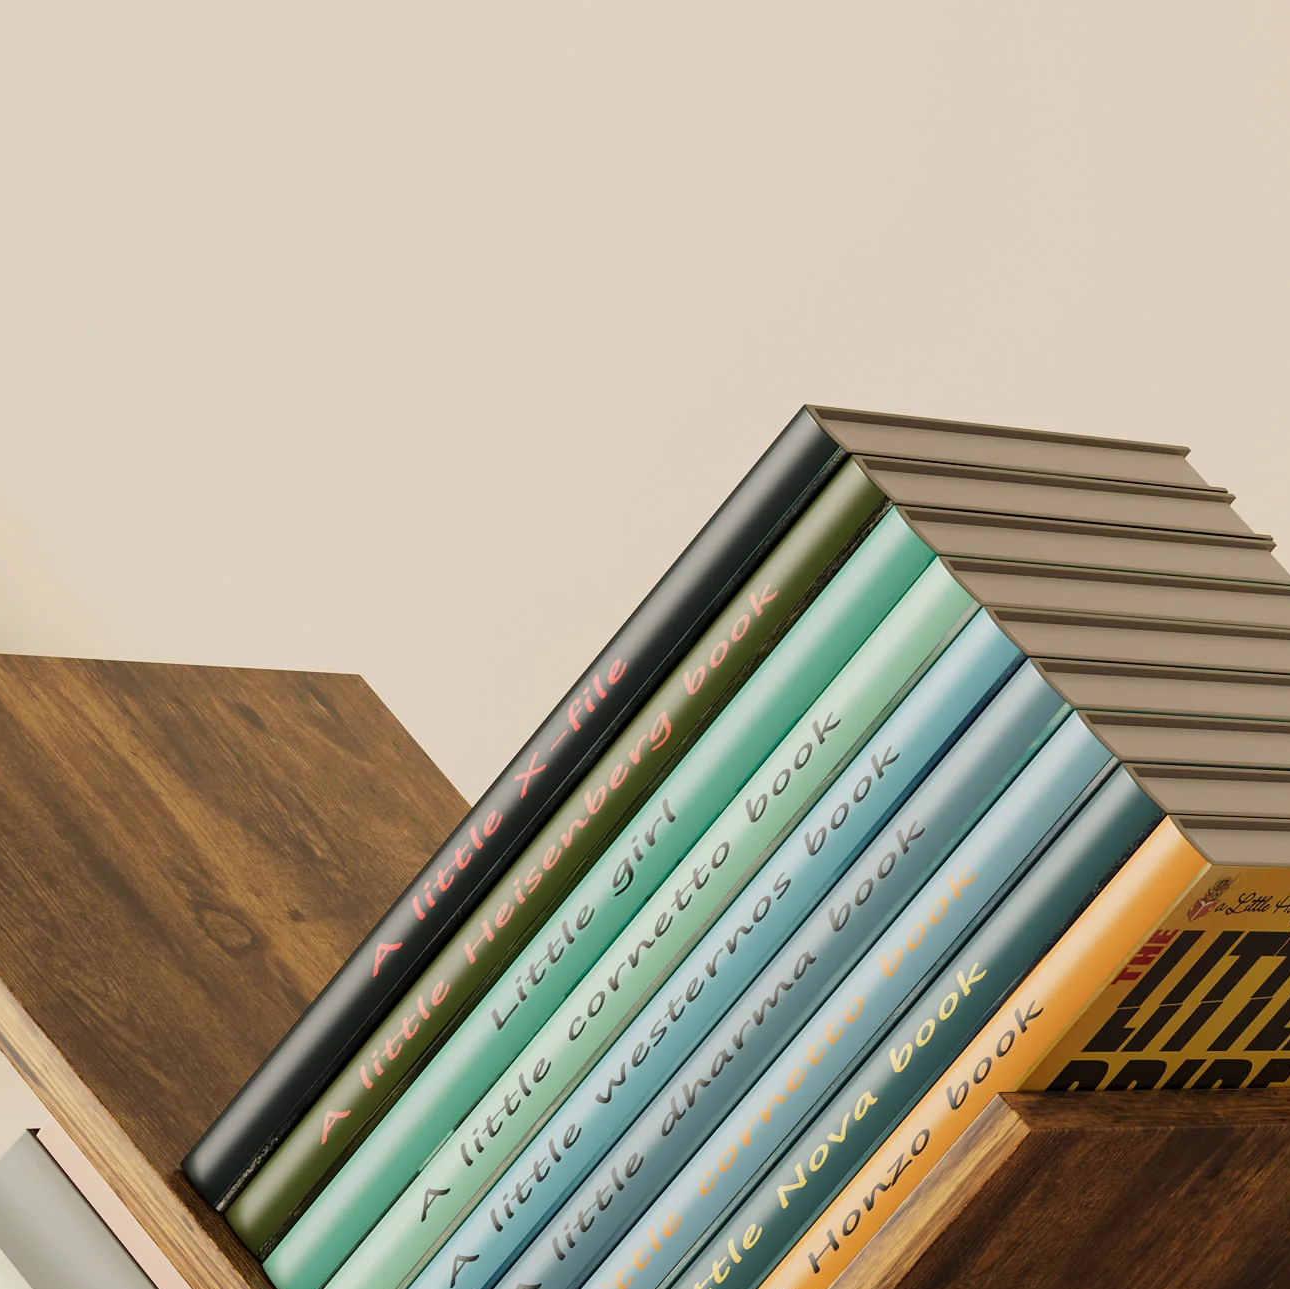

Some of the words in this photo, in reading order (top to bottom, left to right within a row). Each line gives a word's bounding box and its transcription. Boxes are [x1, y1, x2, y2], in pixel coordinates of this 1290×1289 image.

[315, 1102, 351, 1145] A
[357, 976, 454, 1090] little
[461, 714, 672, 967] Heisenberg
[681, 579, 781, 699] book
[365, 935, 403, 978] A
[410, 806, 506, 920] little
[514, 658, 627, 799] X-file
[488, 905, 598, 1032] Little
[609, 799, 676, 897] girl
[1110, 928, 1181, 986] THE
[1225, 892, 1272, 916] Little
[414, 1181, 451, 1222] A
[458, 1053, 555, 1169] little
[567, 837, 729, 1041] cornetto
[745, 713, 843, 826] book
[444, 1247, 480, 1289] A
[488, 1118, 586, 1234] little
[594, 876, 791, 1104] westernos
[804, 746, 901, 860] book
[550, 1147, 647, 1264] little
[660, 946, 817, 1140] dharma
[828, 821, 926, 932] book
[773, 1091, 878, 1211] Nova
[887, 962, 987, 1078] book
[807, 1123, 930, 1274] Honzo
[946, 1003, 1044, 1110] book
